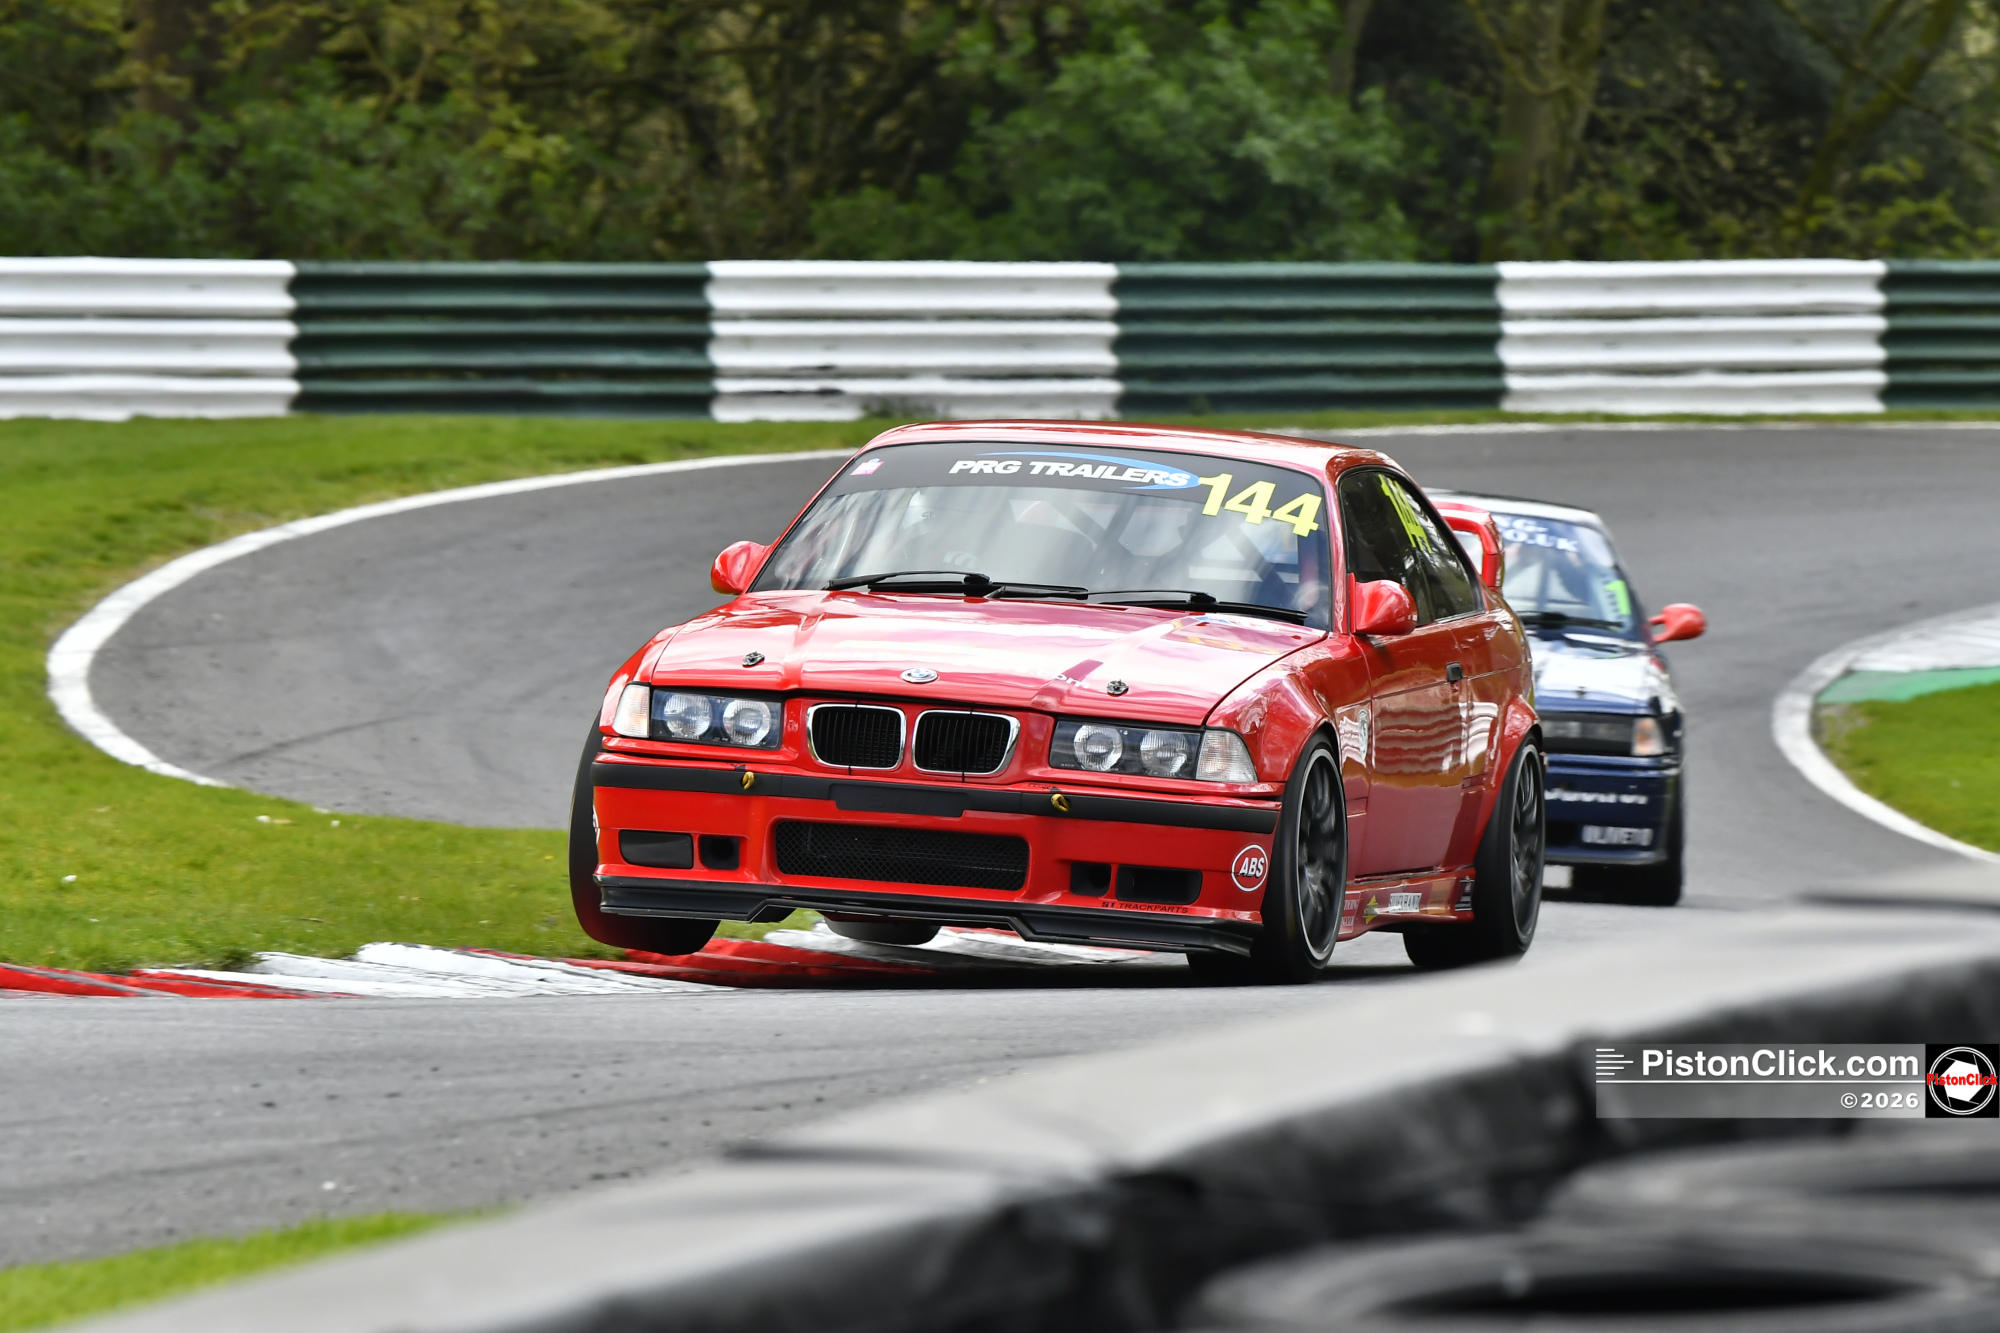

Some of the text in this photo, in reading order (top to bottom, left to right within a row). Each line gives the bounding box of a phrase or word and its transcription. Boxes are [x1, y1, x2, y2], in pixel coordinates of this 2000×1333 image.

[949, 460, 1191, 486] PRG TRAILERS
[1198, 473, 1324, 538] 144
[1237, 857, 1264, 878] ABS
[1119, 902, 1189, 914] TRACKPARTS
